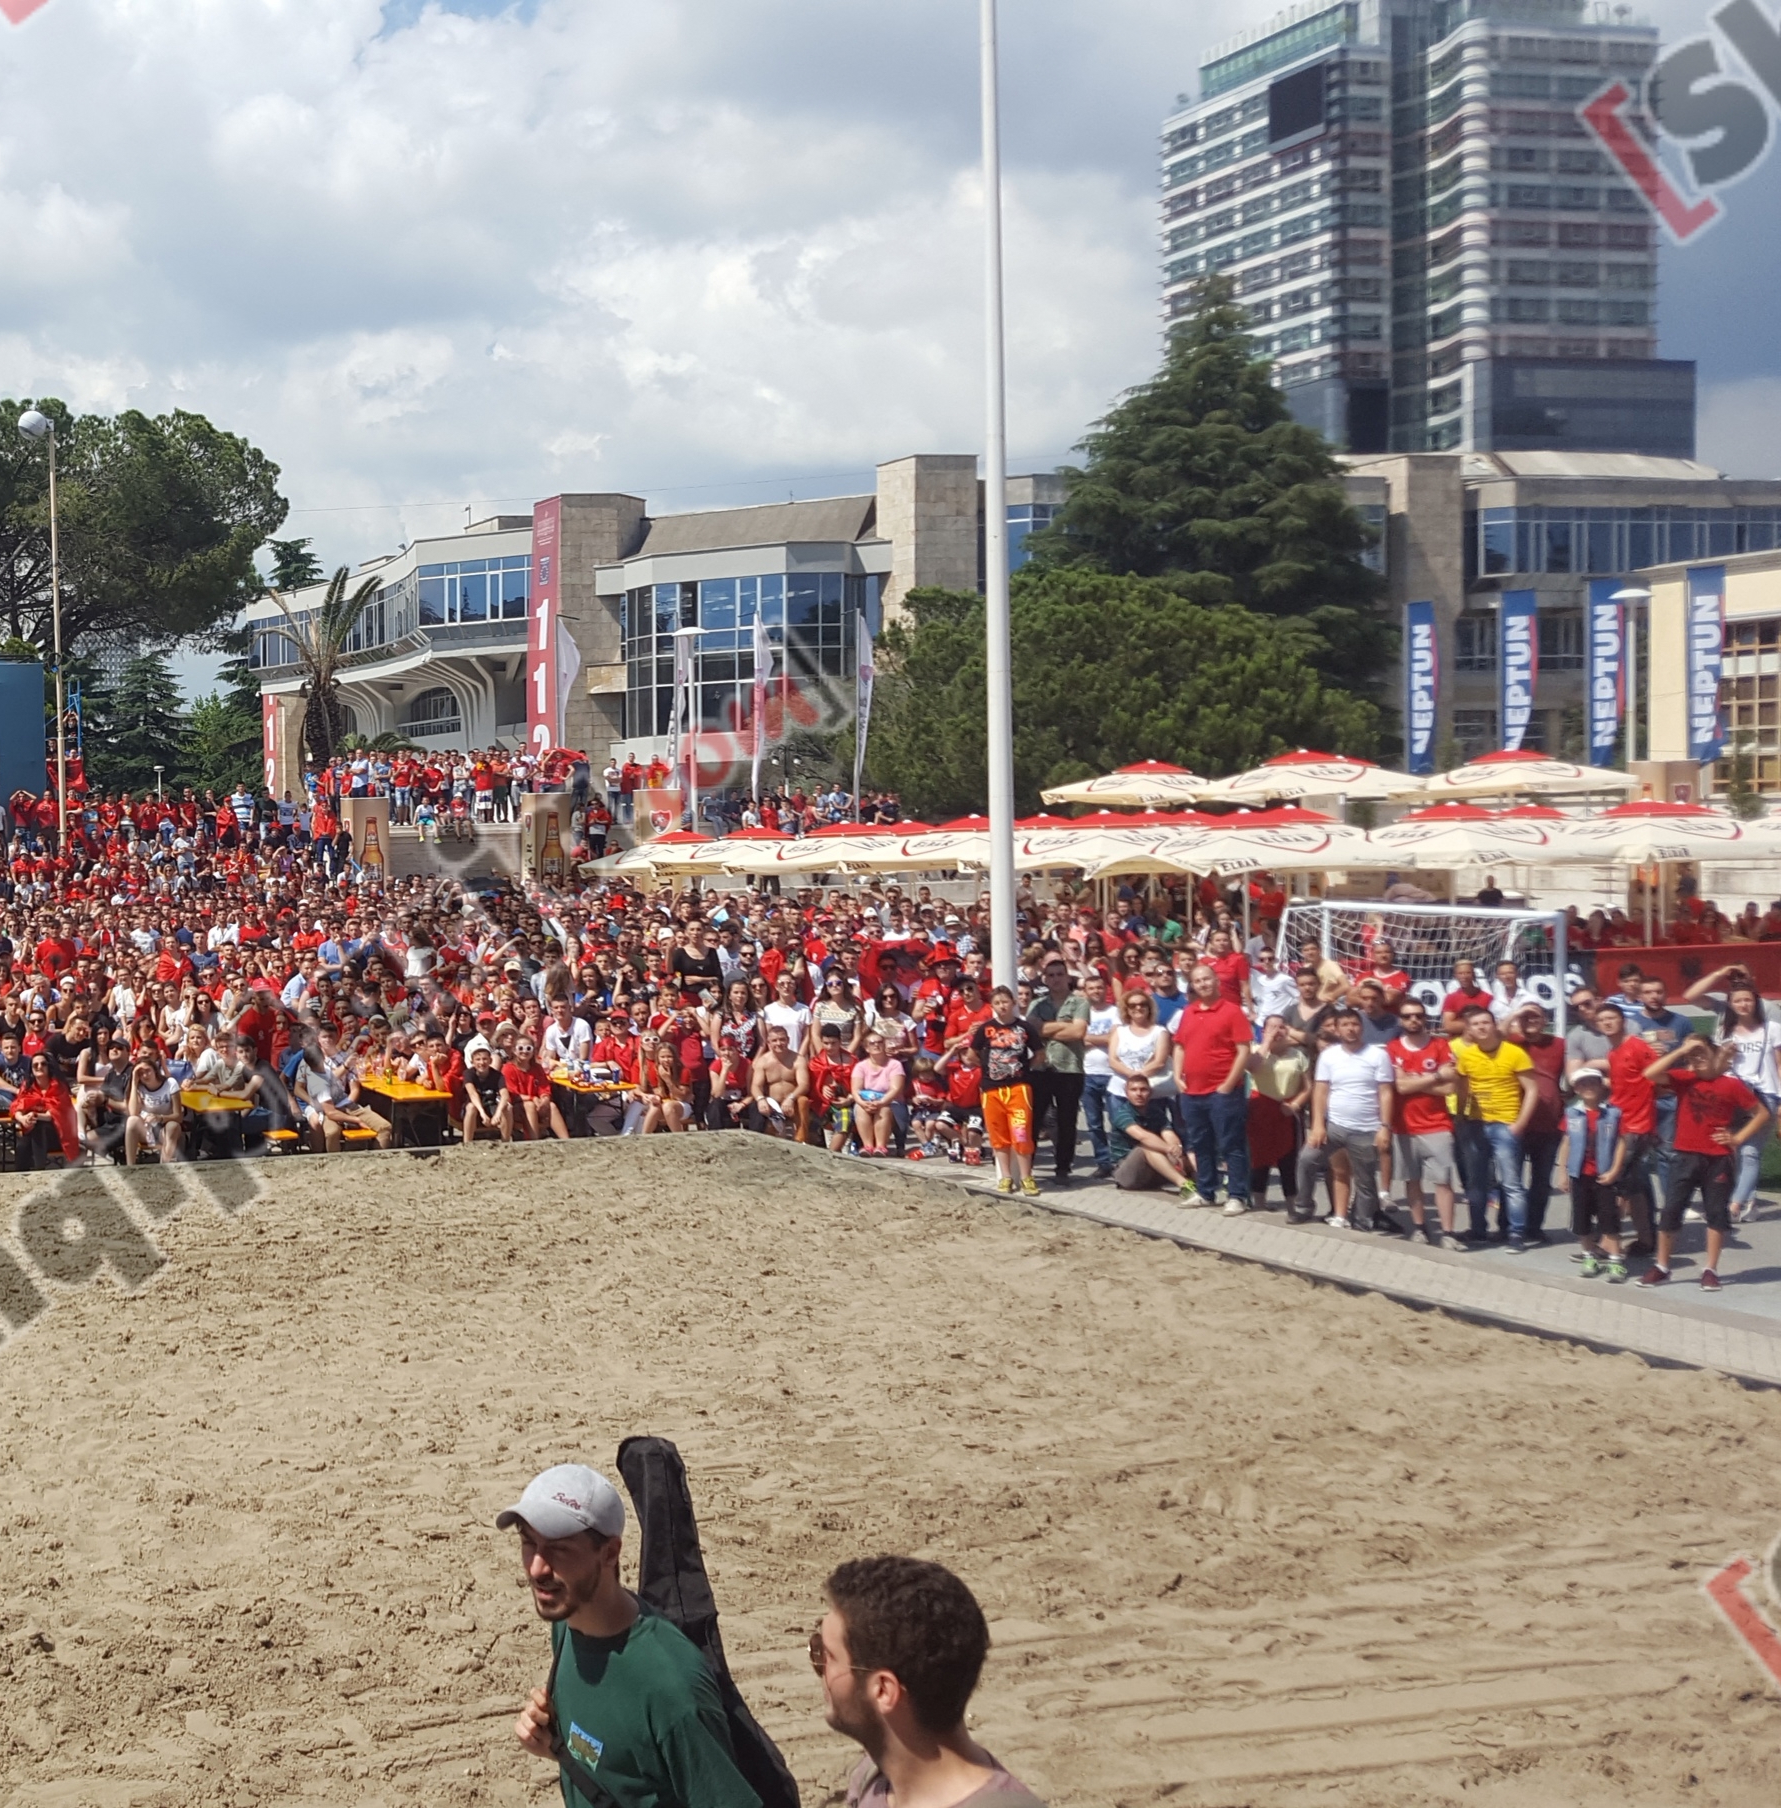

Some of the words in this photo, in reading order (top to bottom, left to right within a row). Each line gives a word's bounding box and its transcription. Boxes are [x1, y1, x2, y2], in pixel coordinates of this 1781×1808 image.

[1412, 623, 1435, 755] NEPTUN
[1504, 615, 1532, 750] NEPTUN
[1592, 604, 1620, 747] NEPTUN
[1691, 595, 1724, 745] NEPTUN
